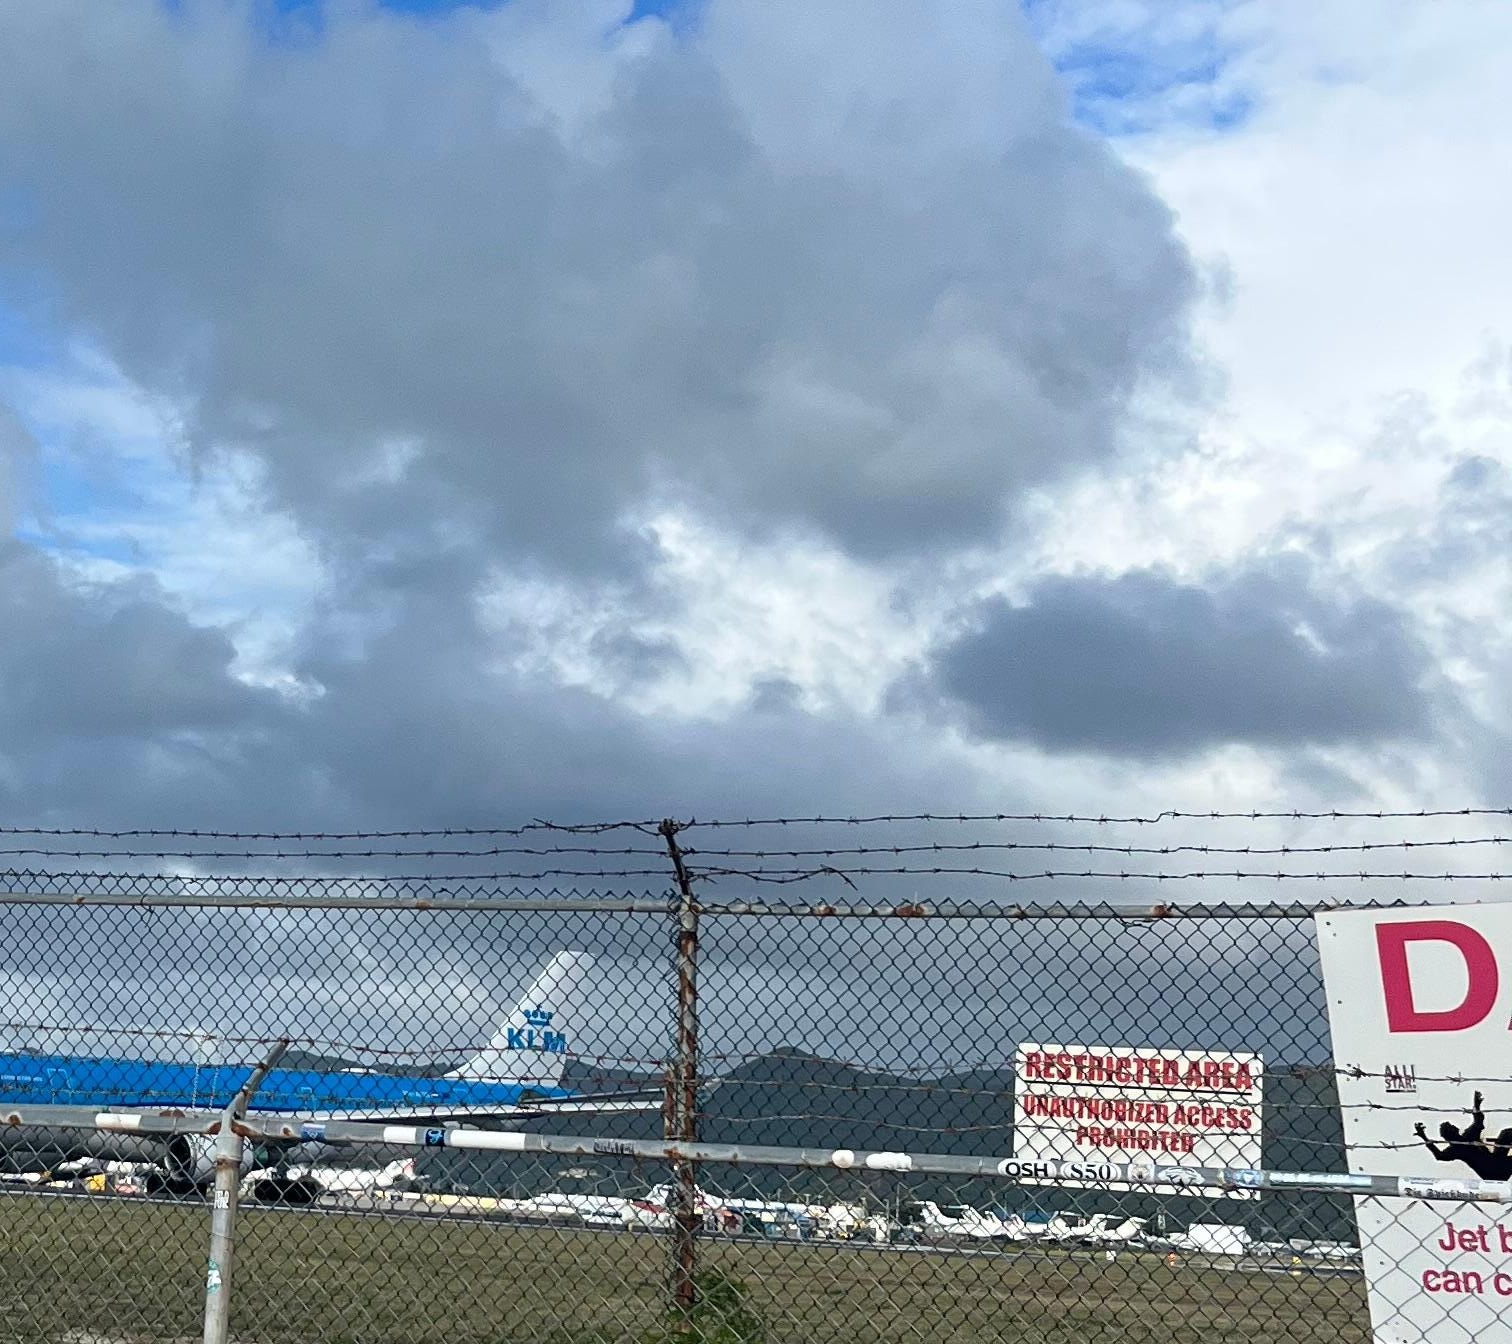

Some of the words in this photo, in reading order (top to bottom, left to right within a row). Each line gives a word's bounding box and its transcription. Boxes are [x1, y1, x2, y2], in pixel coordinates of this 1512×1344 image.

[1375, 920, 1512, 1032] D
[507, 1027, 566, 1055] KLM
[1026, 1052, 1179, 1085] RESTRICTED
[1185, 1060, 1253, 1090] AREA
[1023, 1093, 1169, 1124] UNAUTHORIZED
[1173, 1104, 1252, 1130] ACCESS
[1076, 1124, 1194, 1153] PROHIBITED
[1005, 1162, 1048, 1177] OSH
[1071, 1163, 1111, 1180] S50
[1438, 1222, 1491, 1252] Jet
[1498, 1223, 1512, 1253] b
[1422, 1269, 1484, 1294] can
[1494, 1273, 1512, 1295] c
